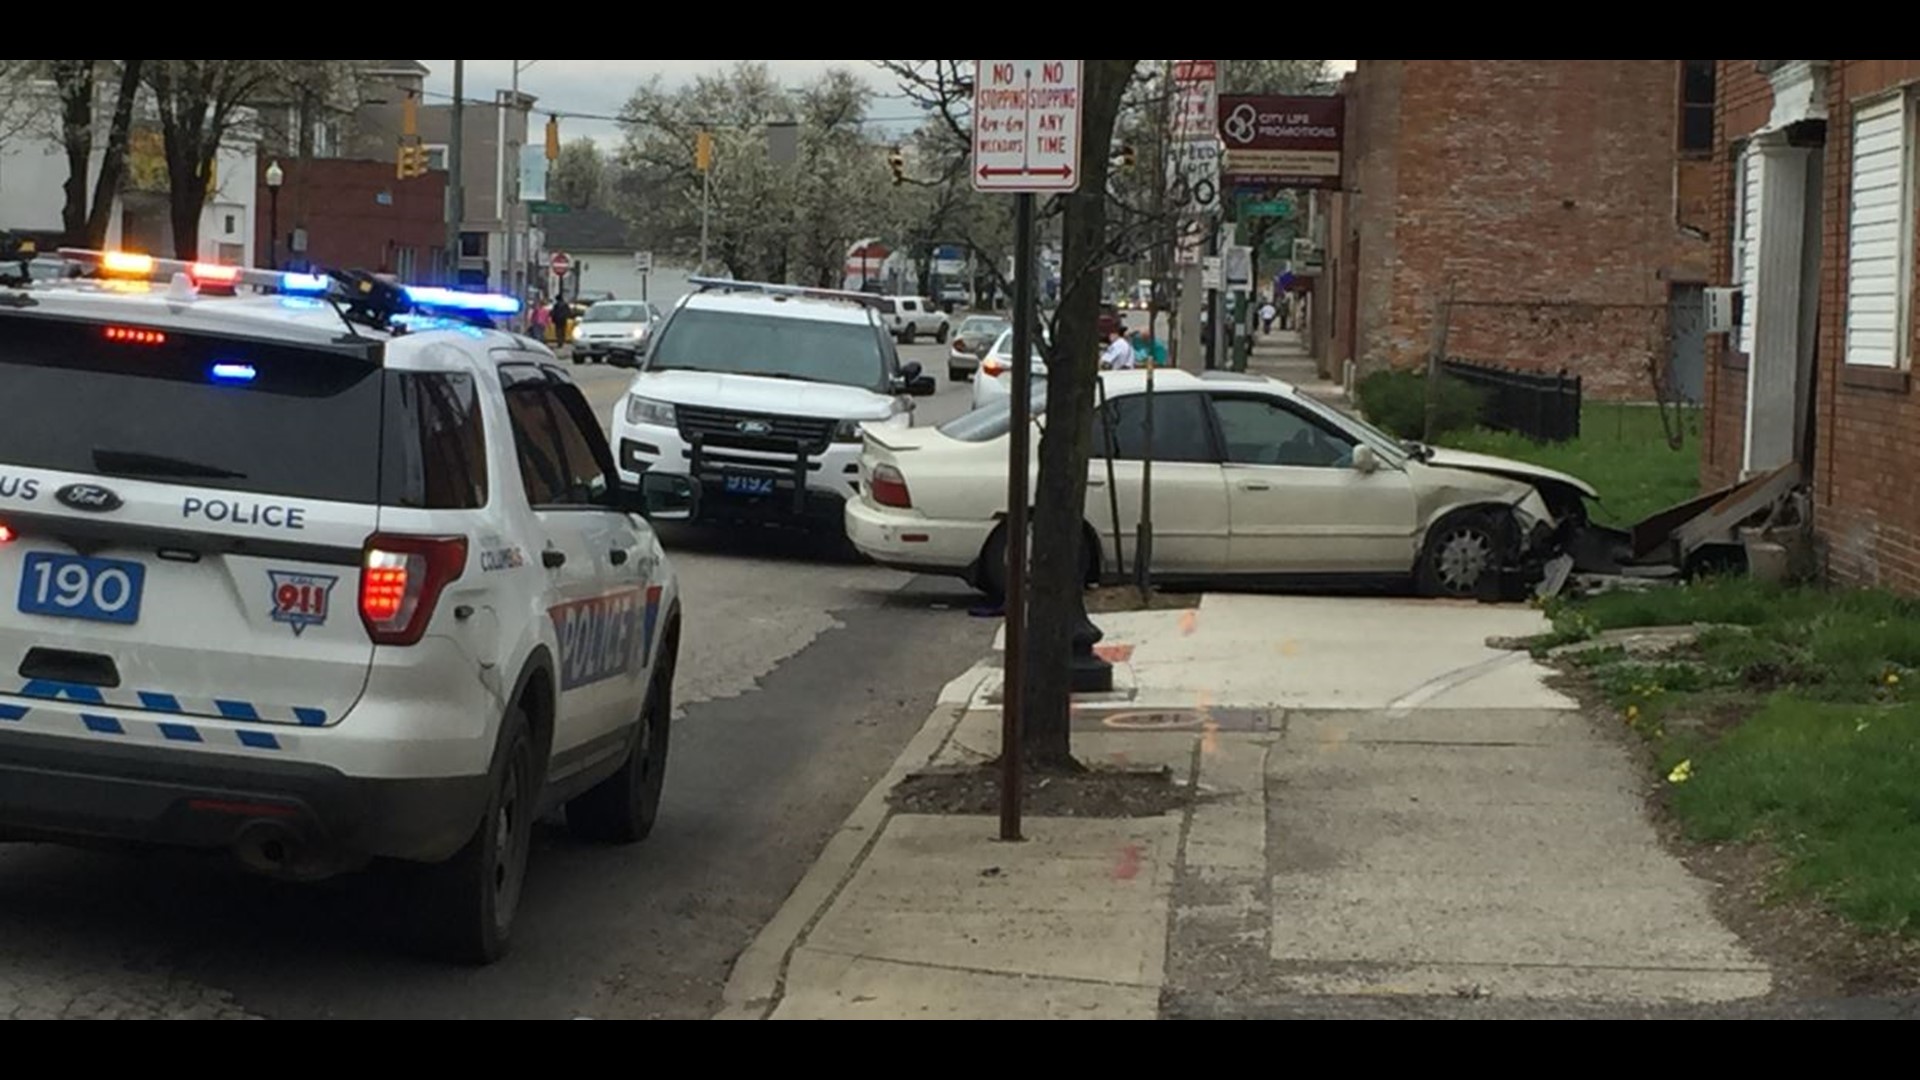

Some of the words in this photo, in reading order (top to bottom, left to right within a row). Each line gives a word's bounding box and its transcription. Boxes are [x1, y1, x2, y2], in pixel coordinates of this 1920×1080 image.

[993, 63, 1014, 85] NO
[1043, 62, 1064, 83] NO
[980, 89, 1026, 110] STOPPING
[1030, 88, 1075, 109] STOPPING
[1039, 115, 1065, 131] ANY
[1258, 113, 1283, 124] CITY
[1287, 114, 1310, 124] LIFE
[1258, 126, 1337, 137] PROMOTIONS
[1037, 136, 1066, 154] TIME
[0, 476, 40, 501] US
[67, 485, 108, 505] Ford
[182, 497, 306, 530] POLICE
[32, 560, 132, 613] 190
[561, 596, 633, 681] POLICE
